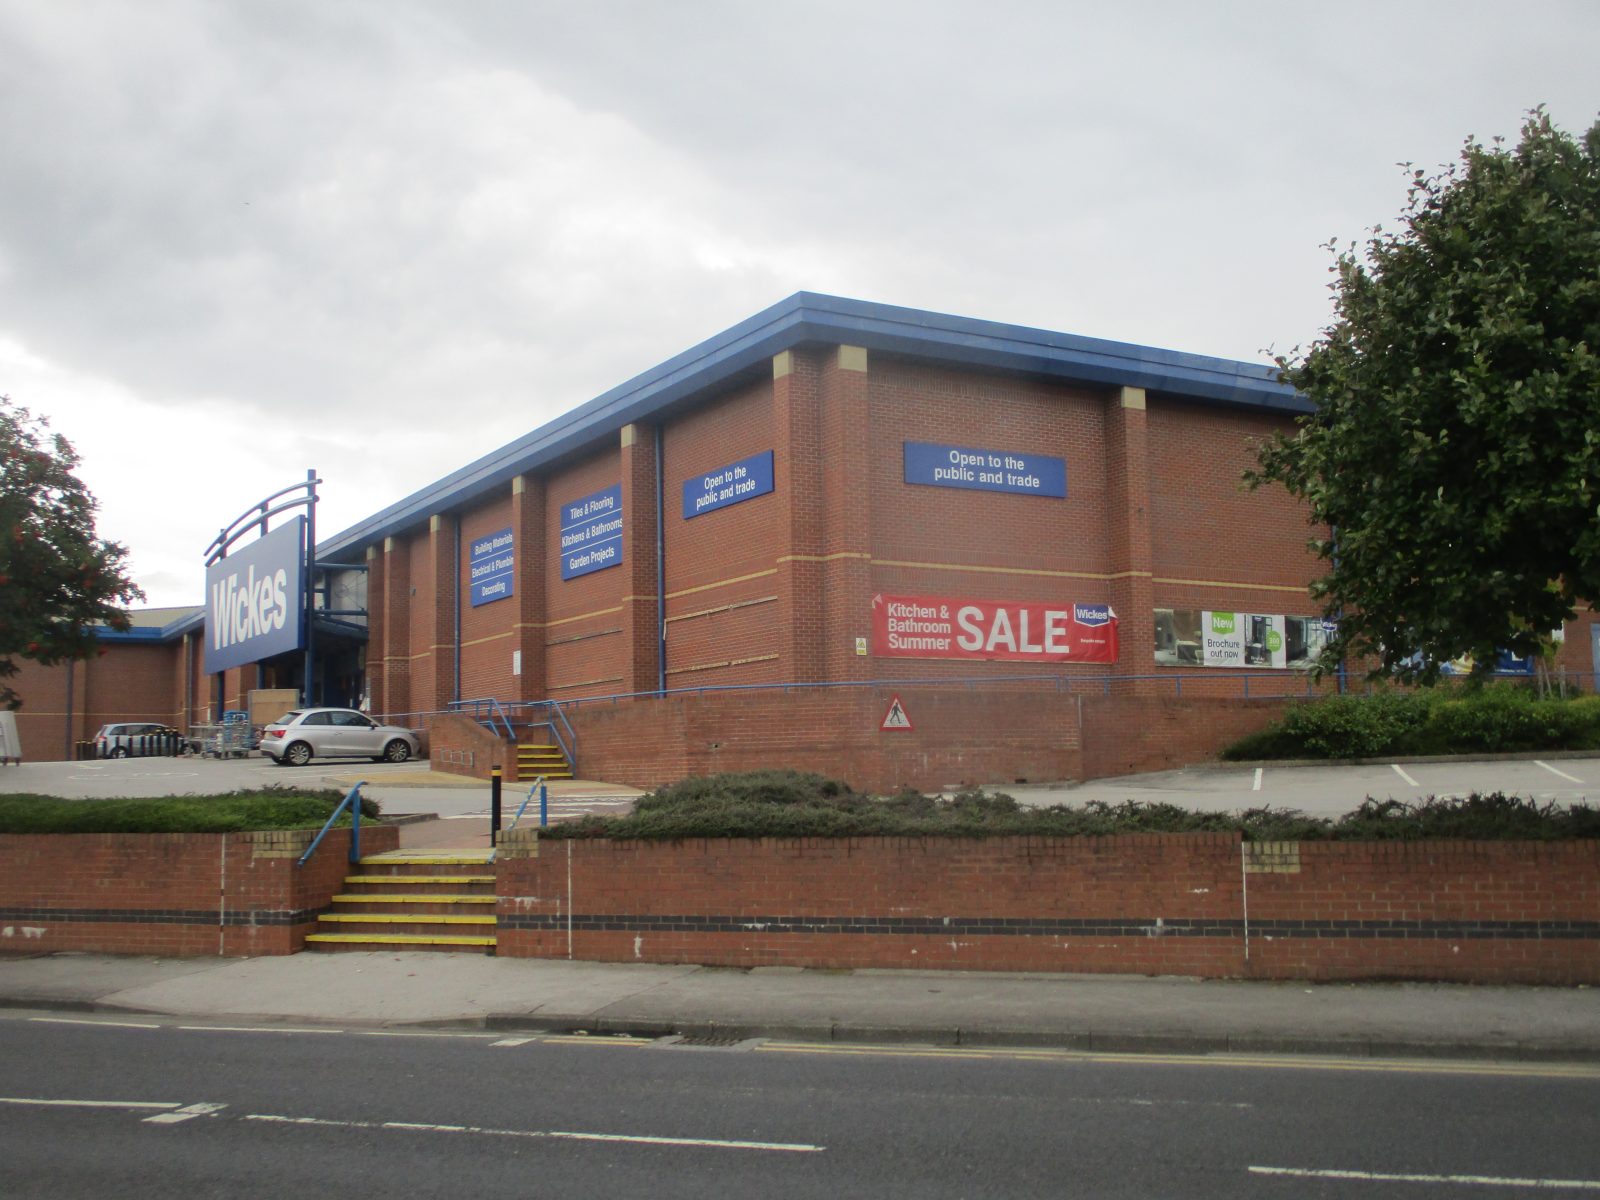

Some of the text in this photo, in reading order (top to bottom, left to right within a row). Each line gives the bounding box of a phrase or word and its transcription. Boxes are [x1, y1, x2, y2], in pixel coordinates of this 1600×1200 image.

[950, 450, 1024, 470] Open to the
[704, 466, 746, 490] Open to the
[935, 467, 1040, 488] public and trade
[696, 478, 755, 511] public and trade
[570, 496, 613, 519] Tiles & Flooring
[562, 518, 622, 548] Kitchens & Bathrooms
[496, 556, 514, 570] Plumbin
[570, 546, 614, 569] Garden Projects
[482, 581, 505, 596] Decorating
[213, 564, 286, 650] Wickes
[888, 602, 949, 619] Kitchen &
[1077, 609, 1107, 619] Wickes
[888, 619, 951, 634] Bathroom
[956, 606, 1070, 653] SALE
[1213, 616, 1233, 629] New
[888, 634, 951, 650] Summer
[1208, 639, 1240, 648] Brochure
